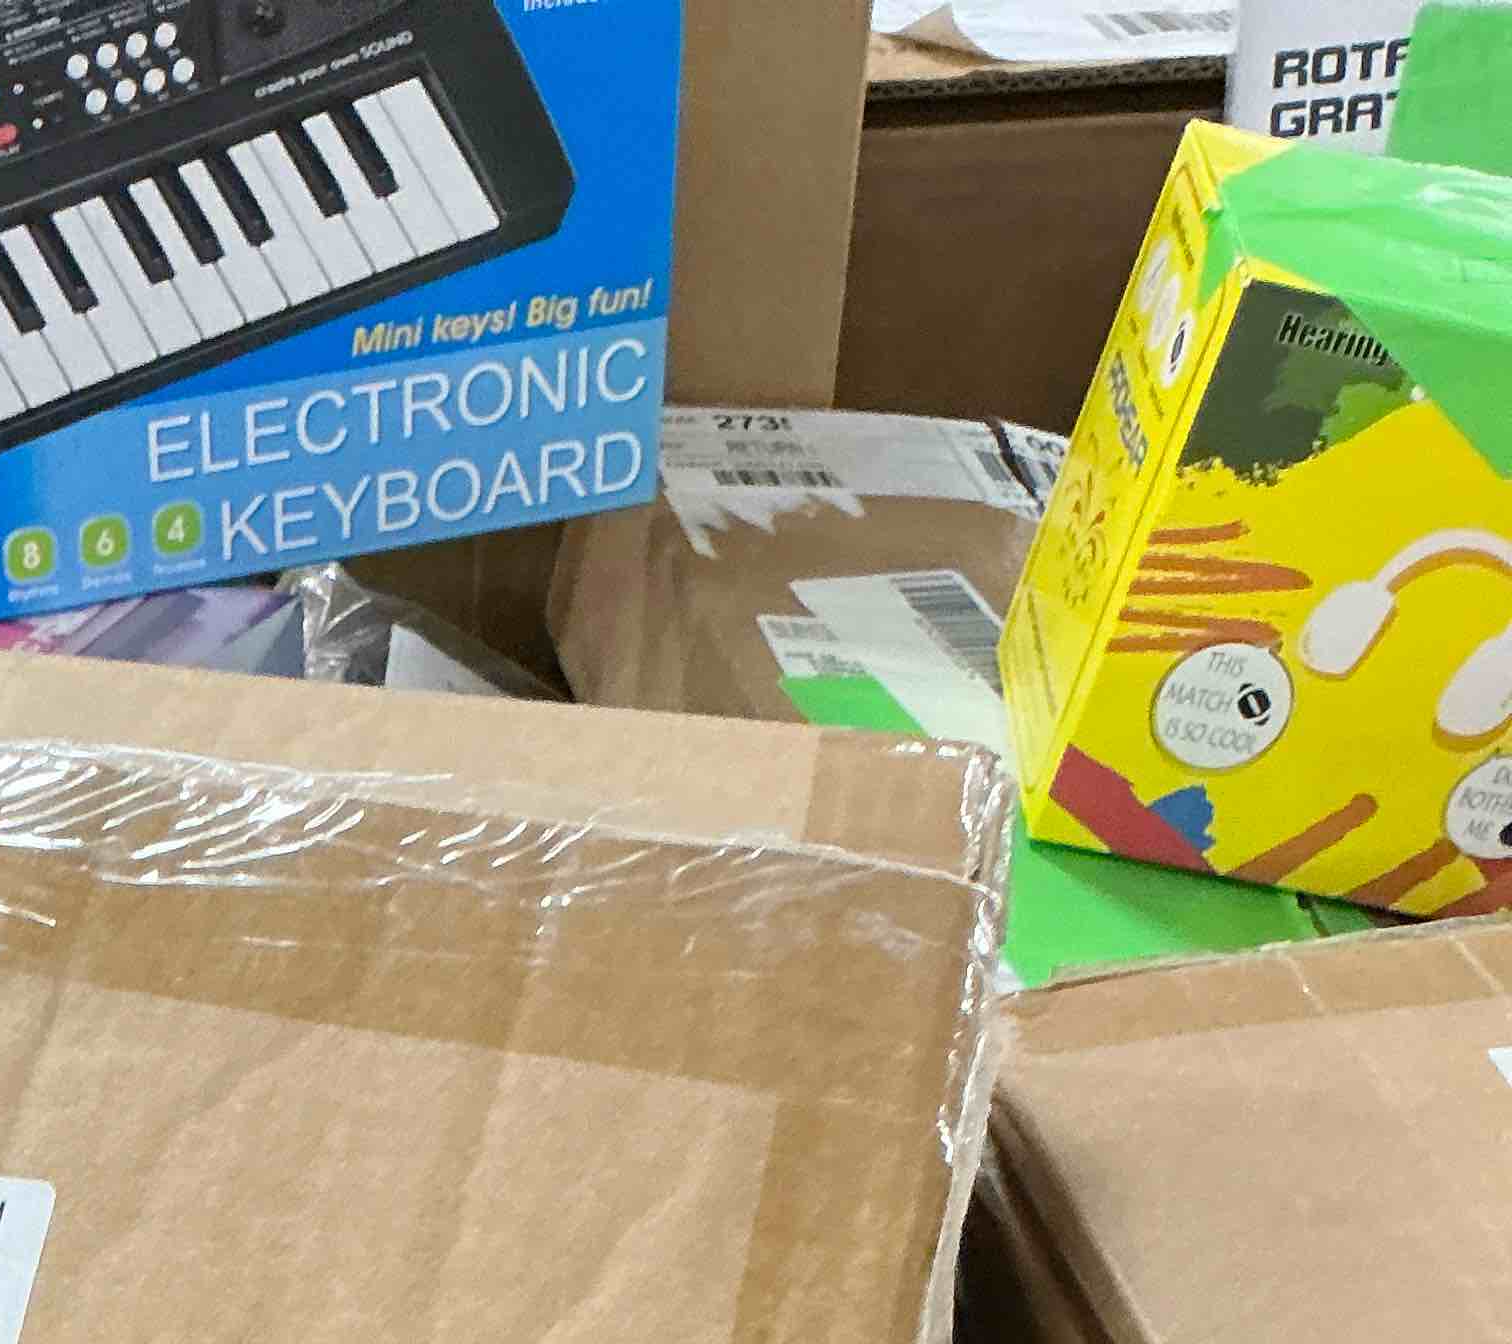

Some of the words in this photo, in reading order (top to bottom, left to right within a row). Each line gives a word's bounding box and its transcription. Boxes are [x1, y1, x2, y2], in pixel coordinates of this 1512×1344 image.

[1270, 89, 1400, 137] GRA
[352, 320, 423, 358] Mini
[433, 303, 515, 352] keys!
[527, 294, 576, 332] Big
[586, 279, 653, 319] fun!
[146, 337, 648, 485] ELECTRONIC
[220, 431, 643, 561] KEYBOARD
[96, 530, 114, 557] 6
[168, 516, 186, 543] 4
[23, 541, 41, 570] 8
[1205, 651, 1248, 677] THIS
[1166, 682, 1235, 713] MATCH
